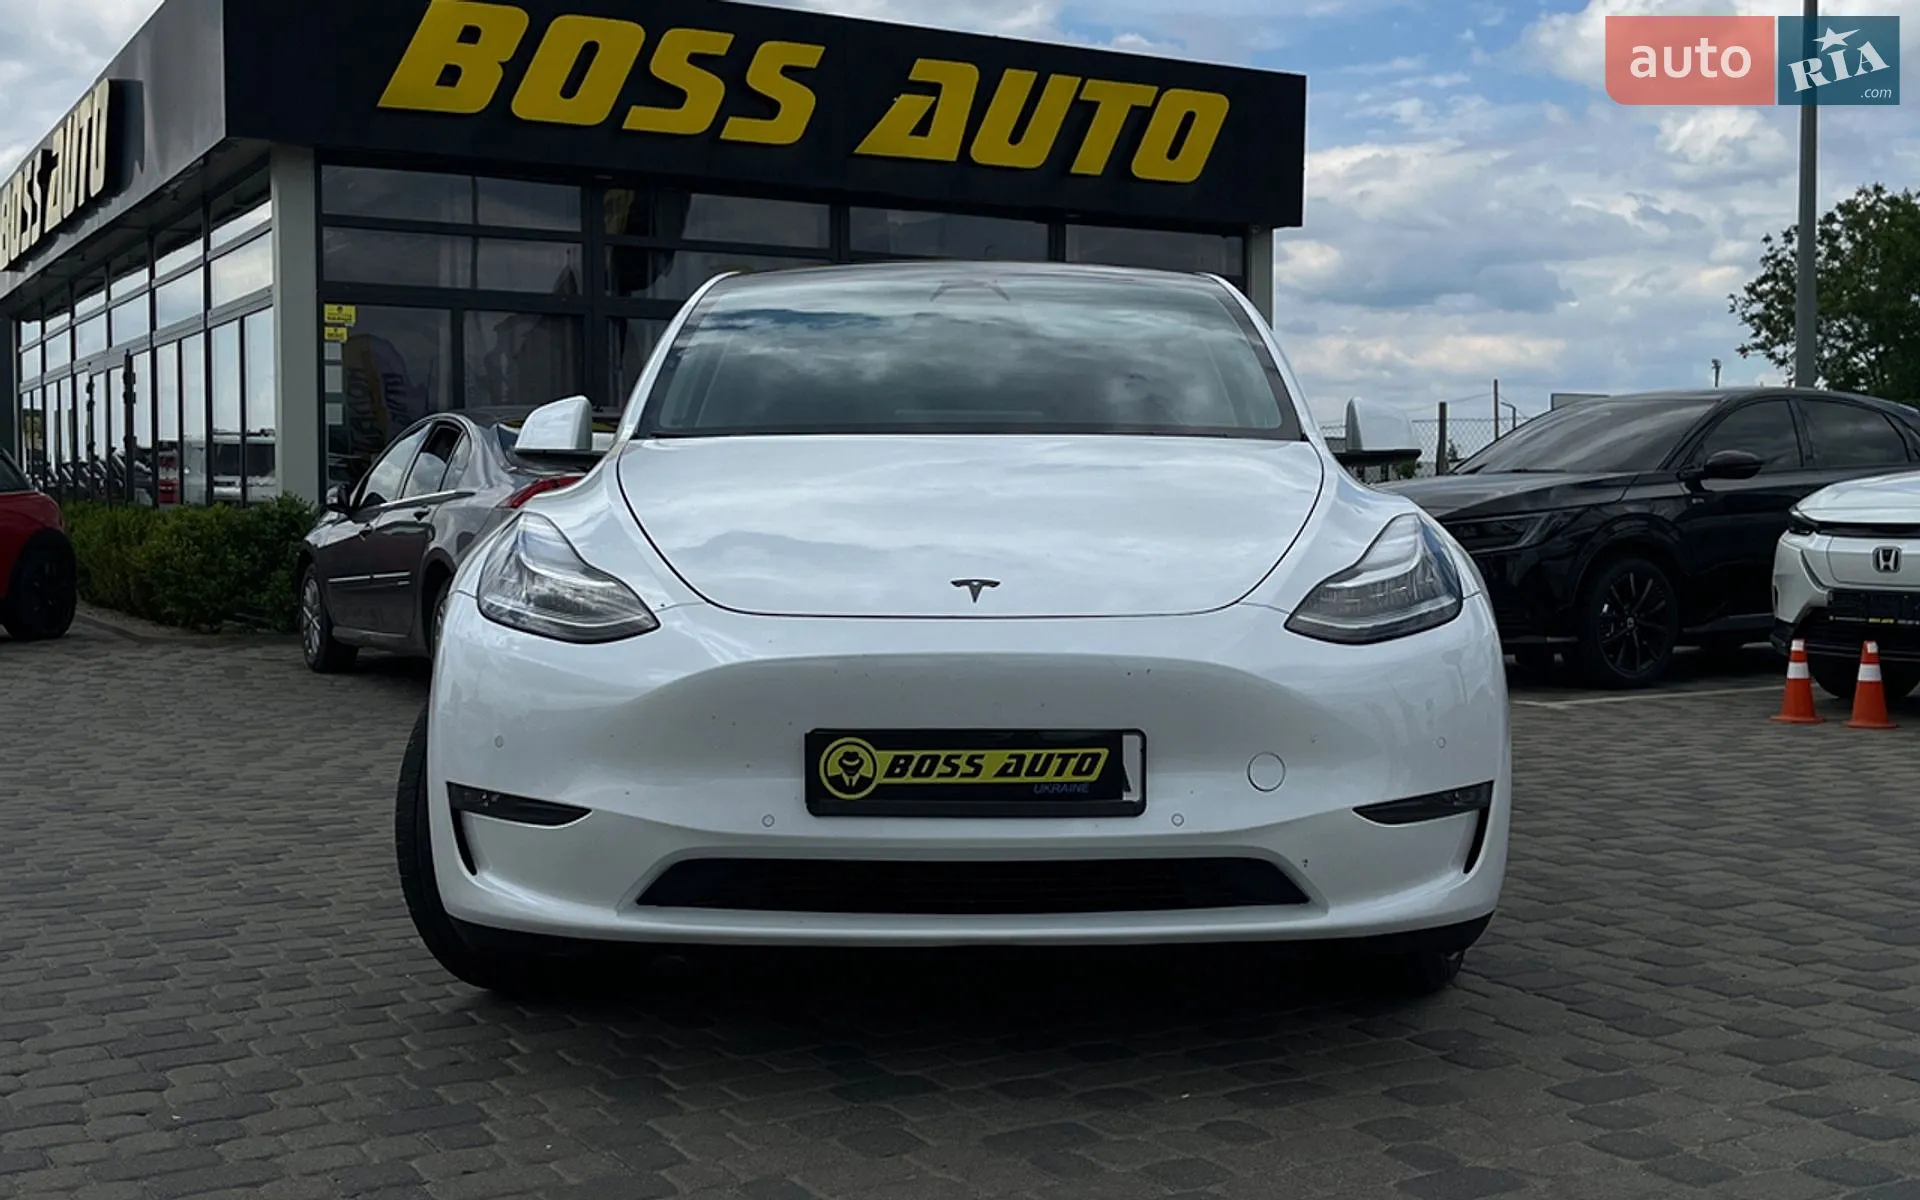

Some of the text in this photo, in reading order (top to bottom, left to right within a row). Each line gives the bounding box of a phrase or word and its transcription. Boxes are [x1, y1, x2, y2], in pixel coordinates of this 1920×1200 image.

[377, 0, 1230, 183] BOSS AUTO
[44, 77, 109, 234] AUTO
[883, 752, 1102, 778] BOSS AUTO
[1033, 783, 1090, 794] UKRAINE
